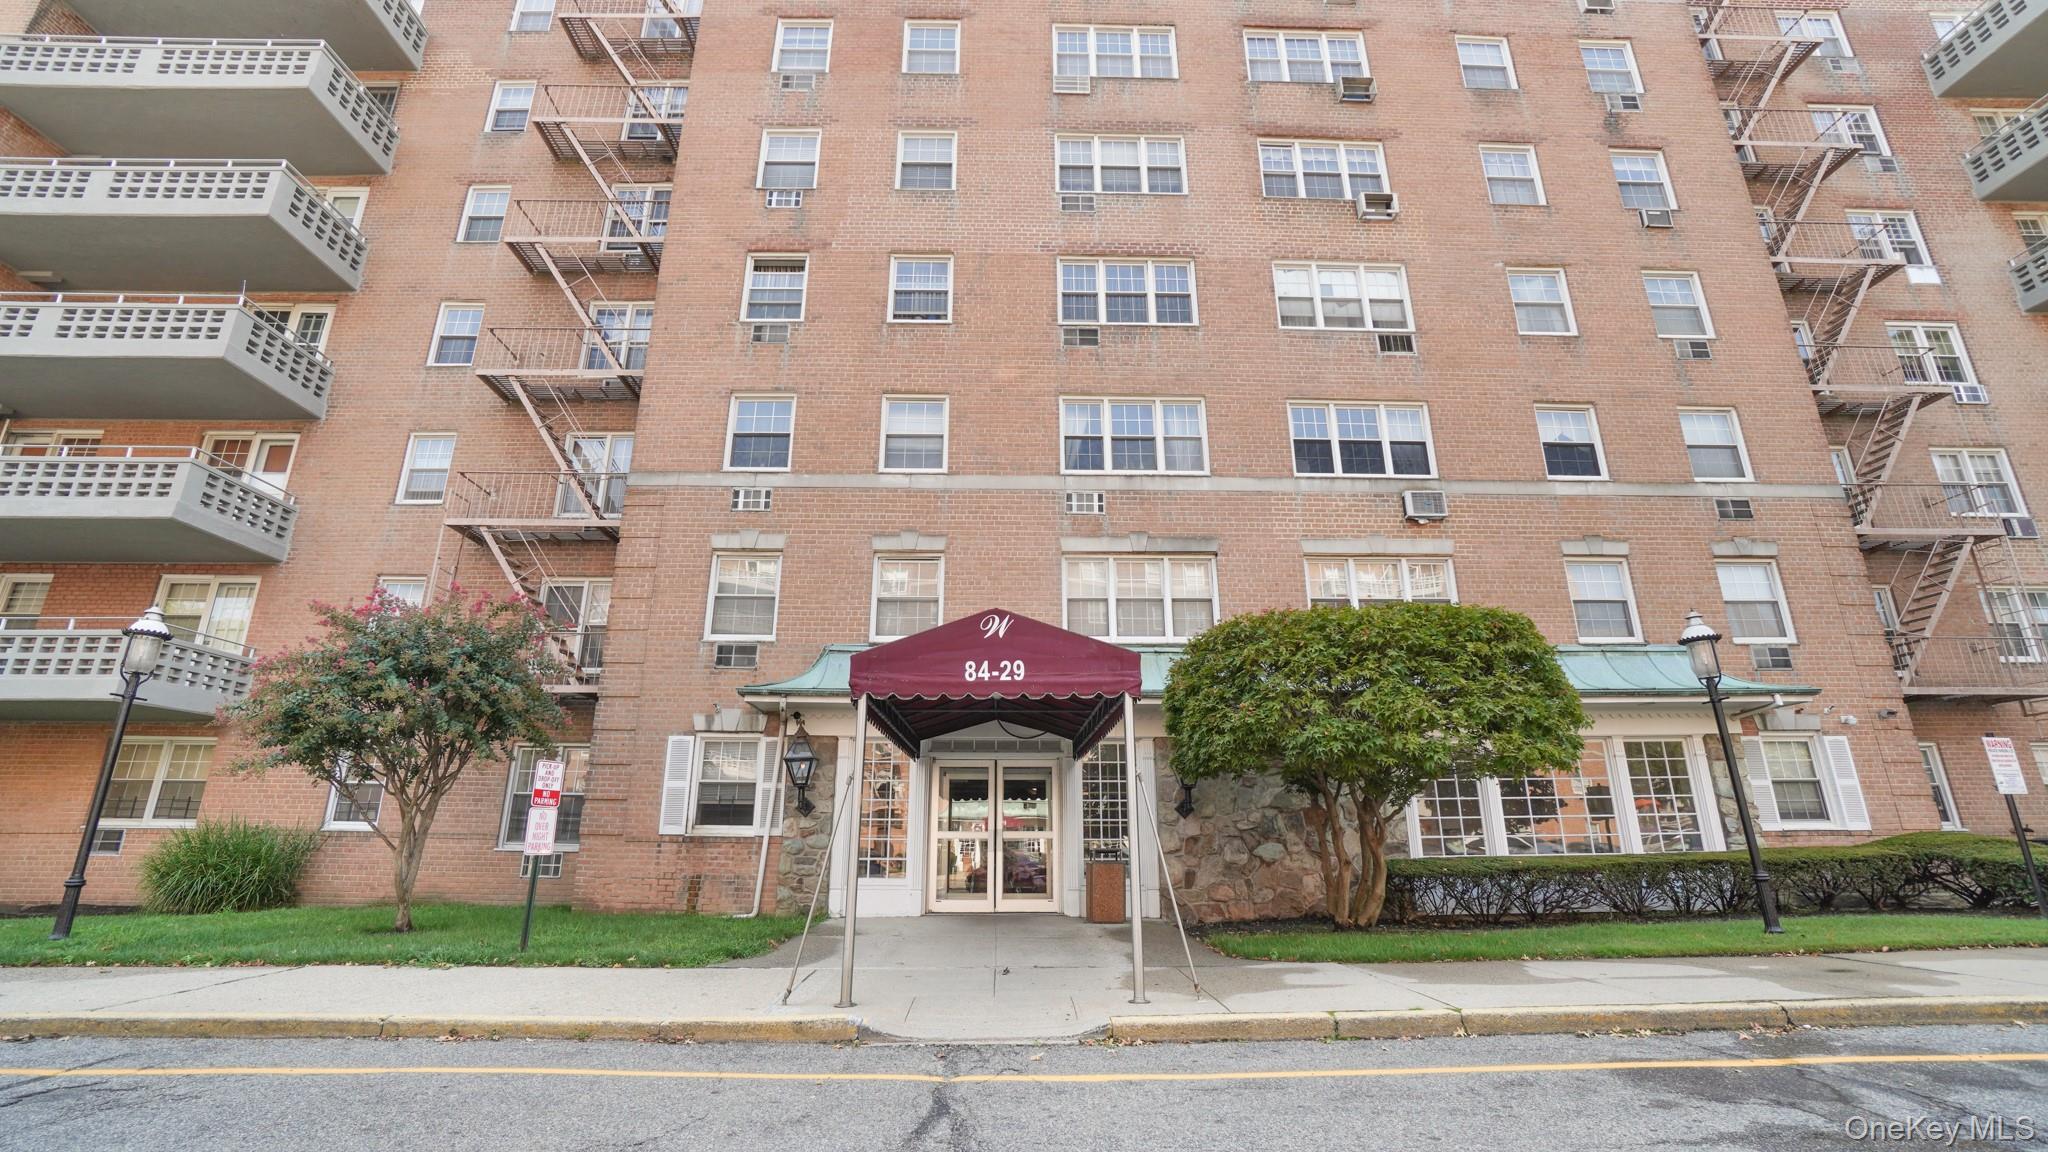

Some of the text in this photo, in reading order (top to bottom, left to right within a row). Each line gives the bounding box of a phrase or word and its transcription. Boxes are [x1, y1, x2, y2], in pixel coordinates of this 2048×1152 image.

[964, 659, 1025, 681] 84-29
[1986, 739, 2012, 748] WARNING
[533, 797, 557, 806] PARKING
[539, 812, 547, 820] NO
[535, 822, 549, 831] OVER
[532, 832, 548, 840] NIGHT
[527, 842, 551, 850] PARKING
